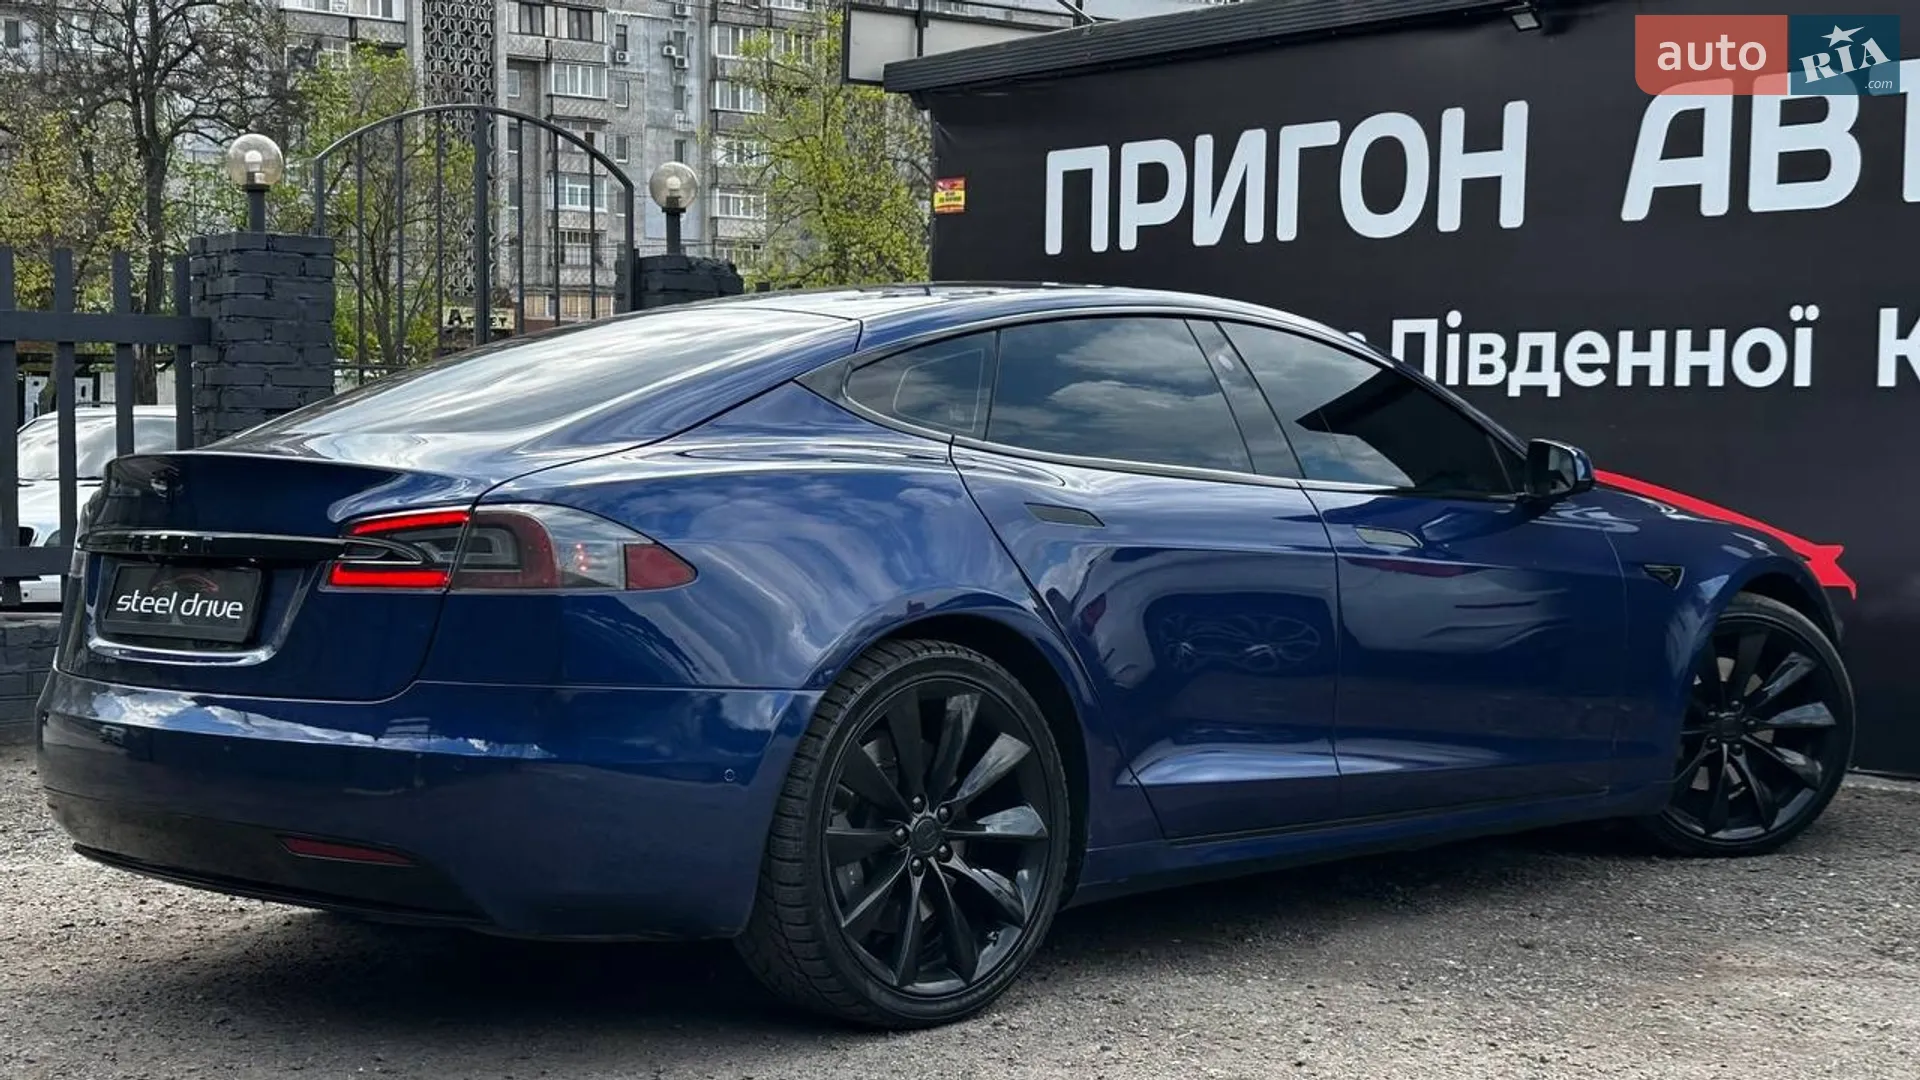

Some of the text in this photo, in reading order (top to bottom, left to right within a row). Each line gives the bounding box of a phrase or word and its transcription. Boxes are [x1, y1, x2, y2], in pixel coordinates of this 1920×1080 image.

[1045, 100, 1529, 255] ПРИГОН
[1391, 304, 1820, 398] Південної
[116, 589, 243, 620] steel drive
